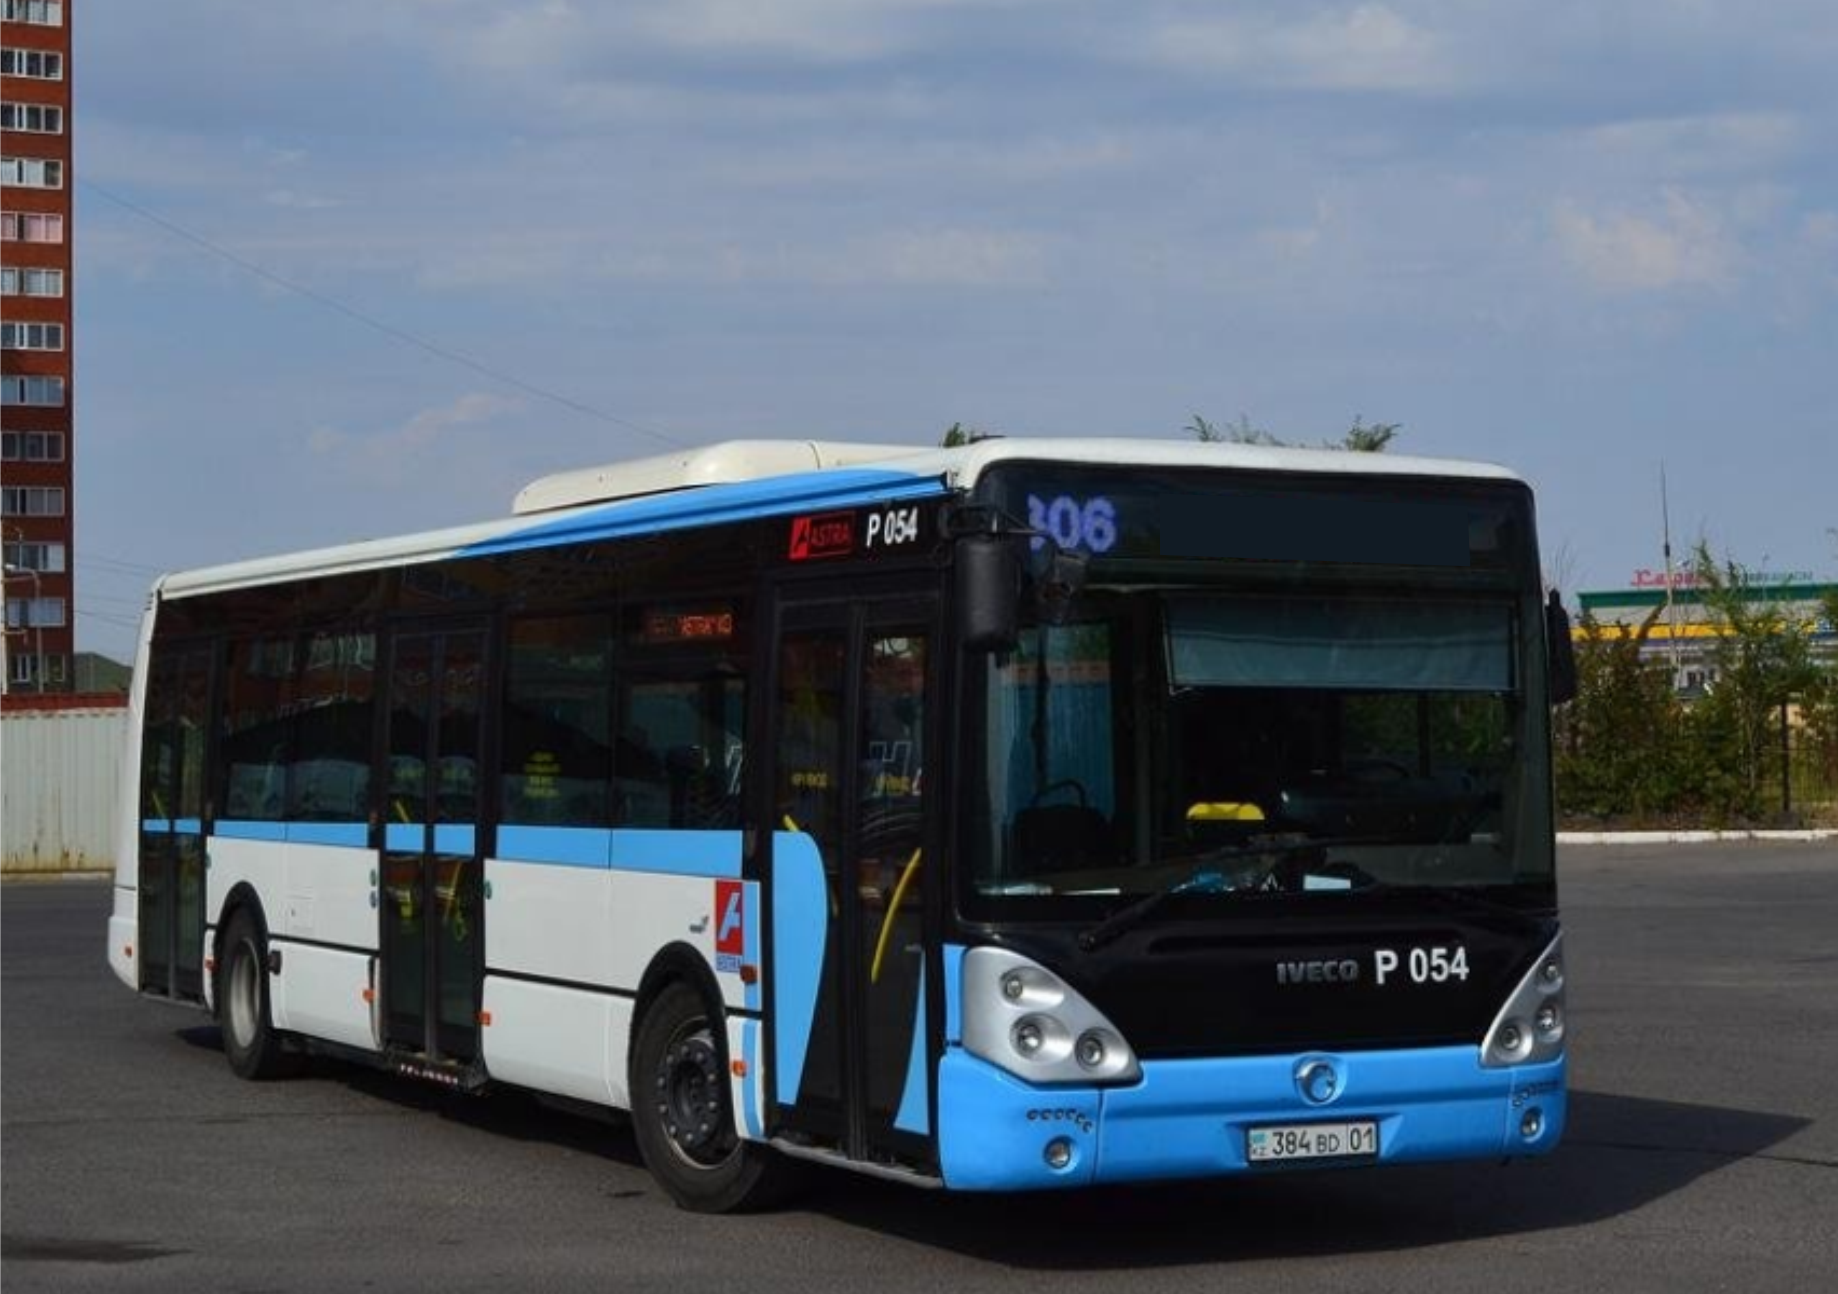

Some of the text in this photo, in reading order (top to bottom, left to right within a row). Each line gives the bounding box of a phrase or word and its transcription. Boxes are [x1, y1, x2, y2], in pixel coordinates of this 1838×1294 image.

[866, 506, 919, 548] P 054
[1276, 959, 1359, 983] IVECO
[1374, 946, 1470, 985] P 054
[1272, 1127, 1374, 1155] 384 BD 01
